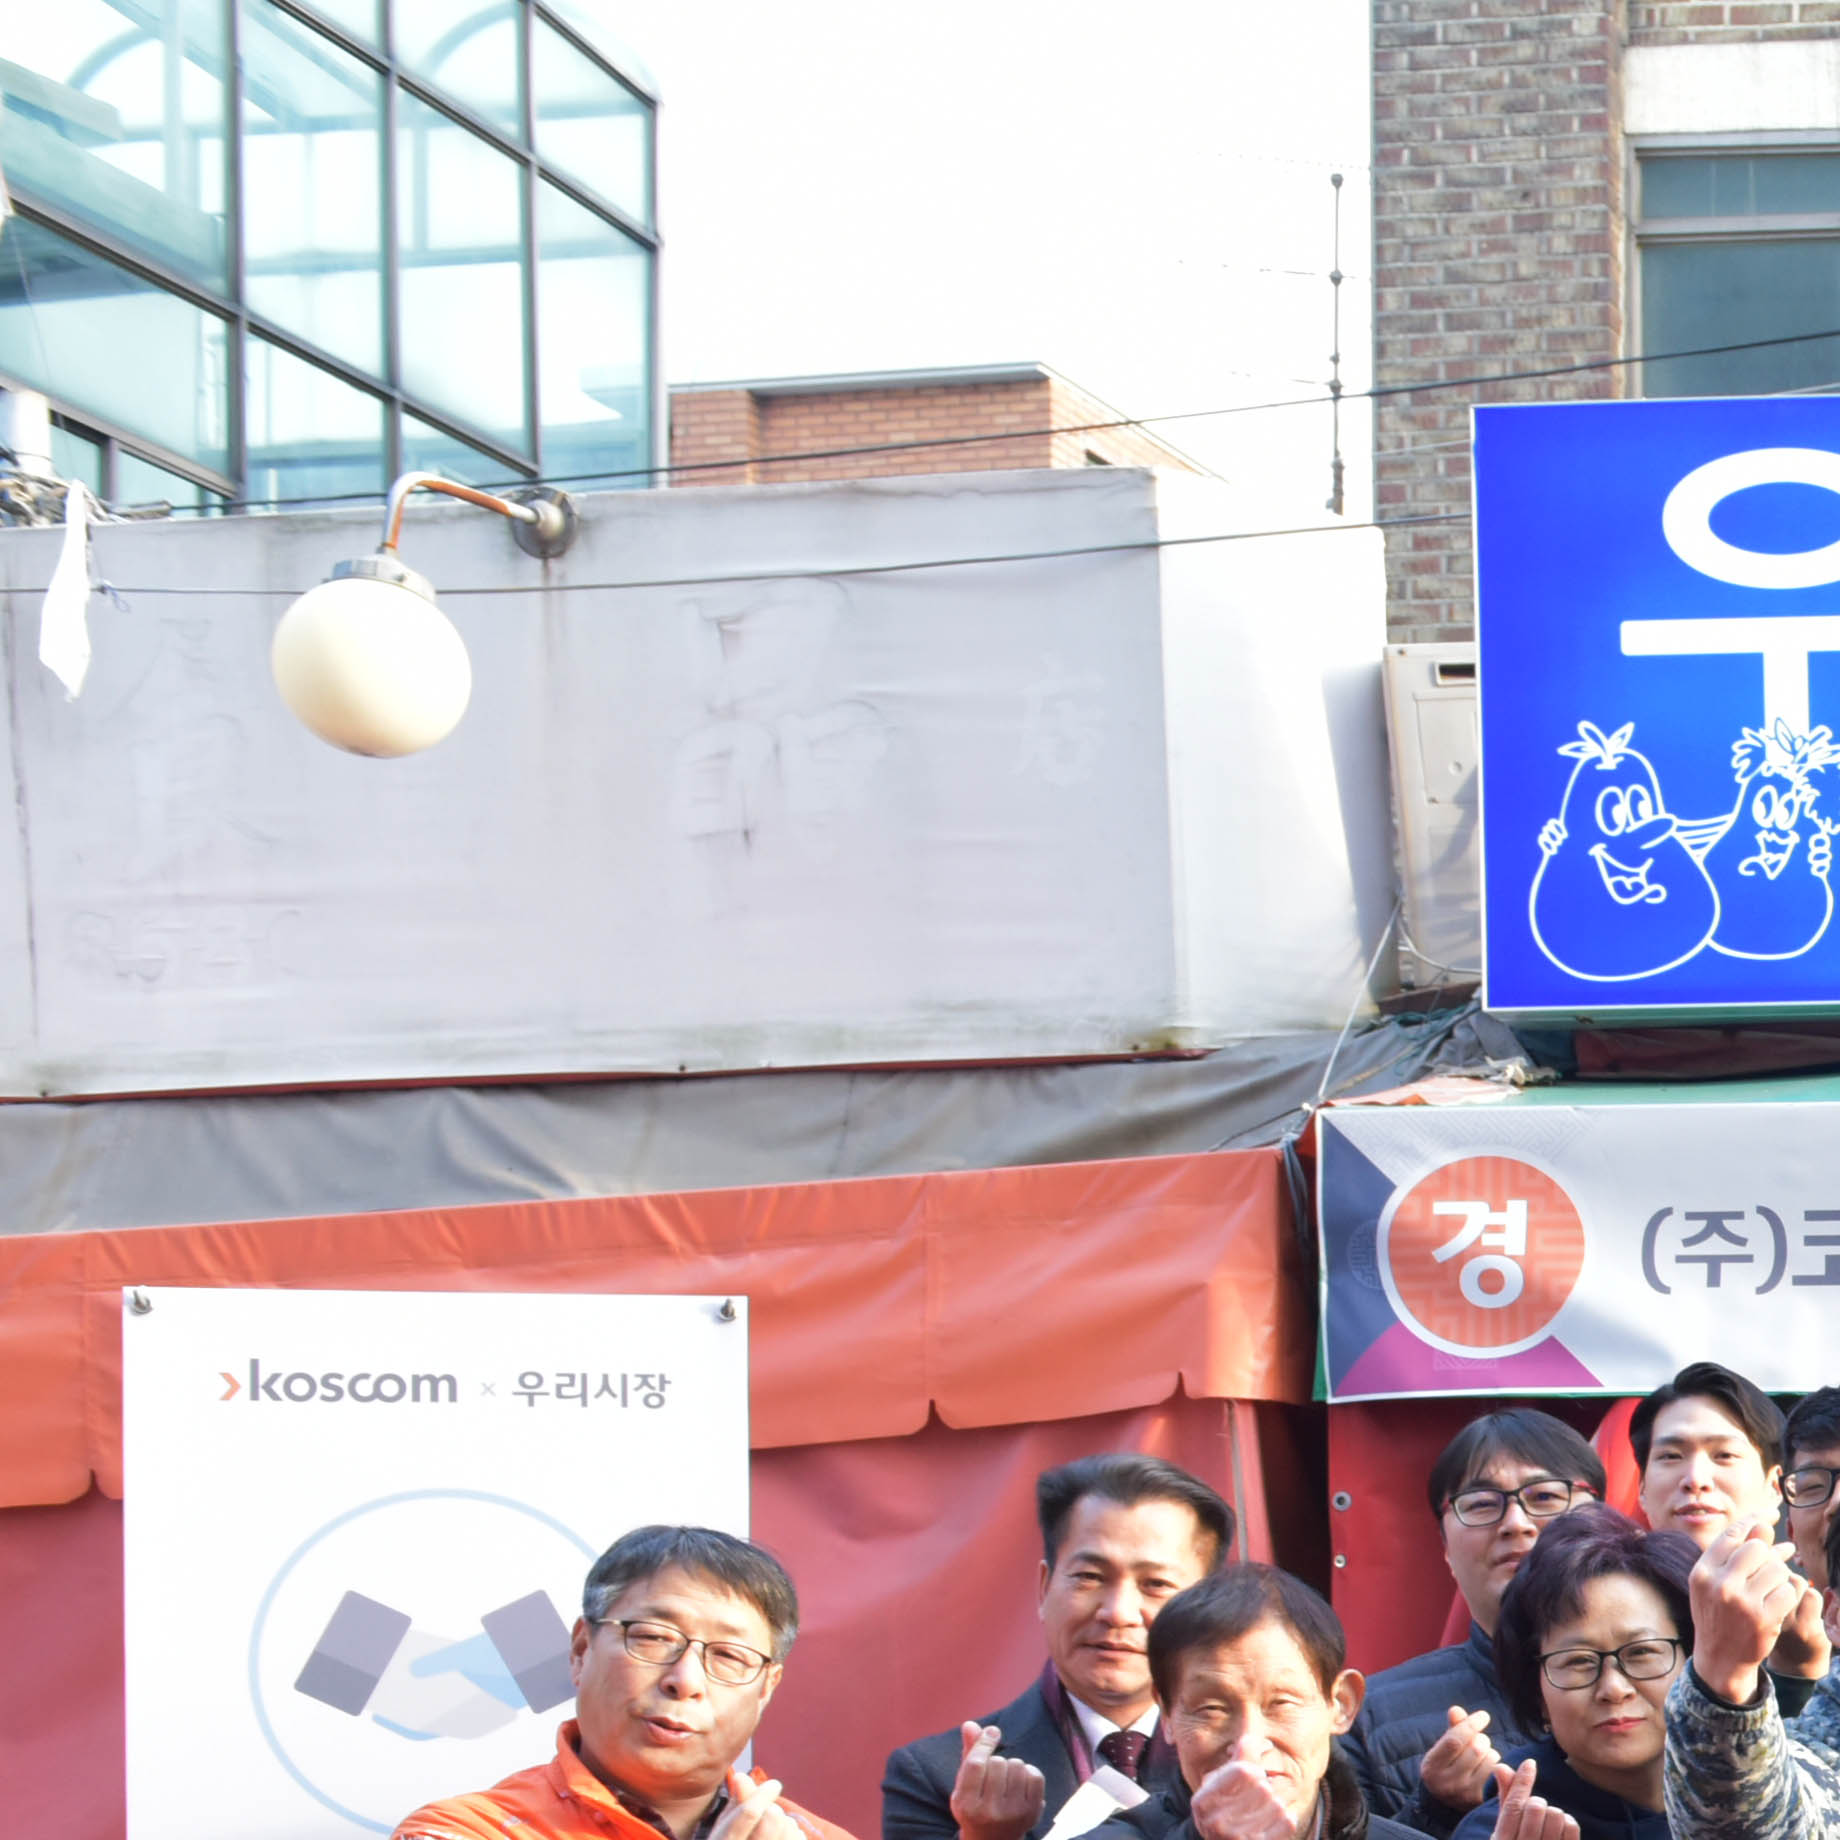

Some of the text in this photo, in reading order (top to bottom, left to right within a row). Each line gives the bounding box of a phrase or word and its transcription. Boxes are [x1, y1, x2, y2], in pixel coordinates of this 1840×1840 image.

[1431, 1197, 1529, 1308] 경
[249, 1357, 458, 1404] koscom
[511, 1370, 673, 1410] 우리시장
